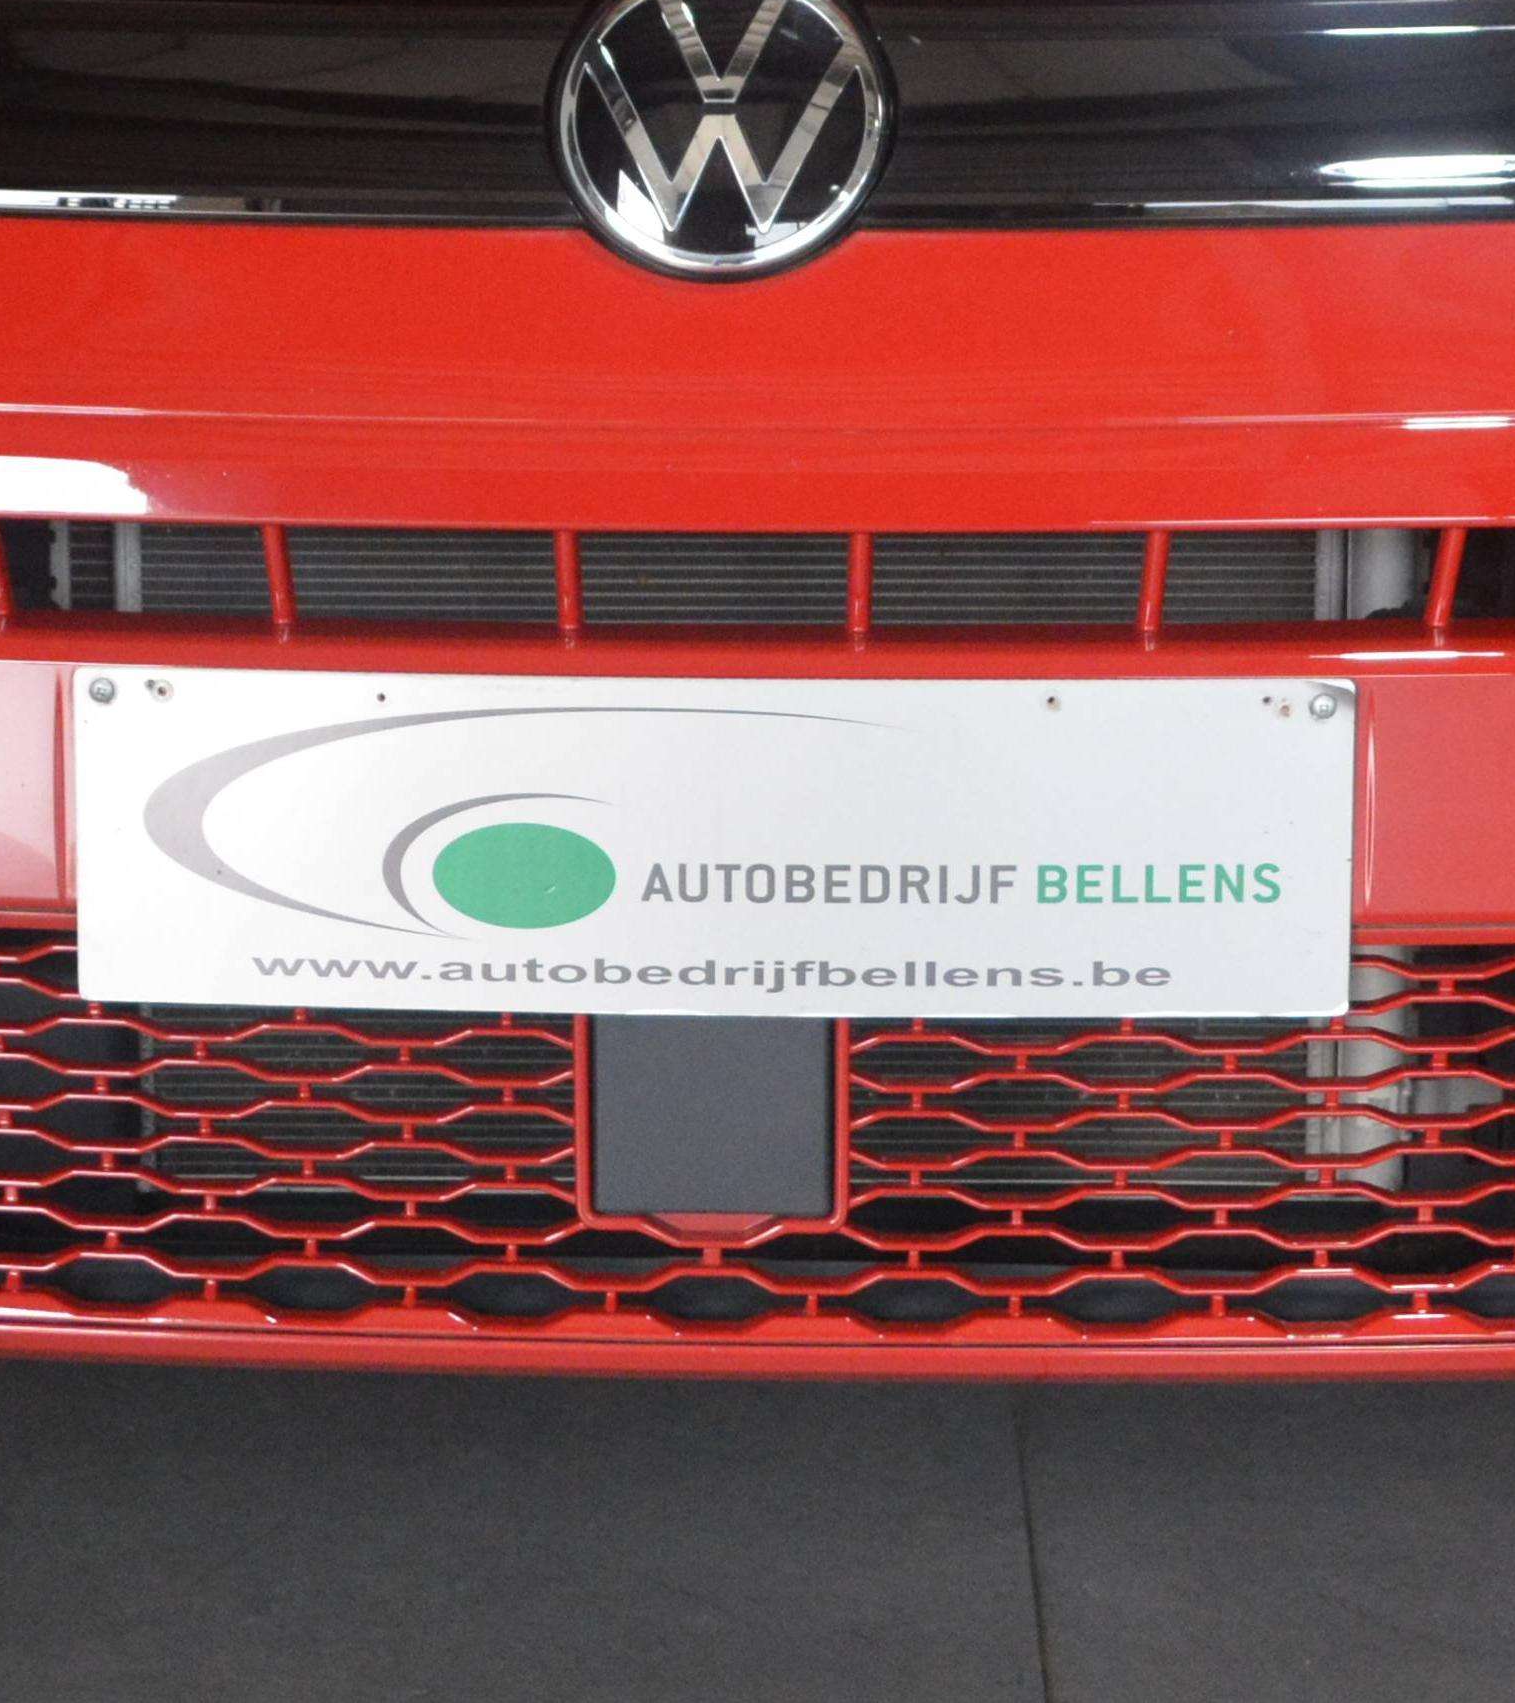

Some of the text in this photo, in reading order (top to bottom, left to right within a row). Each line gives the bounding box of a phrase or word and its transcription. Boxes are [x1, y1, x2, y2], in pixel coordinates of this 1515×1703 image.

[640, 862, 1282, 905] AUTOBEDRIJF BELLENS
[251, 956, 1173, 993] www.autobedrijfbellens.be
